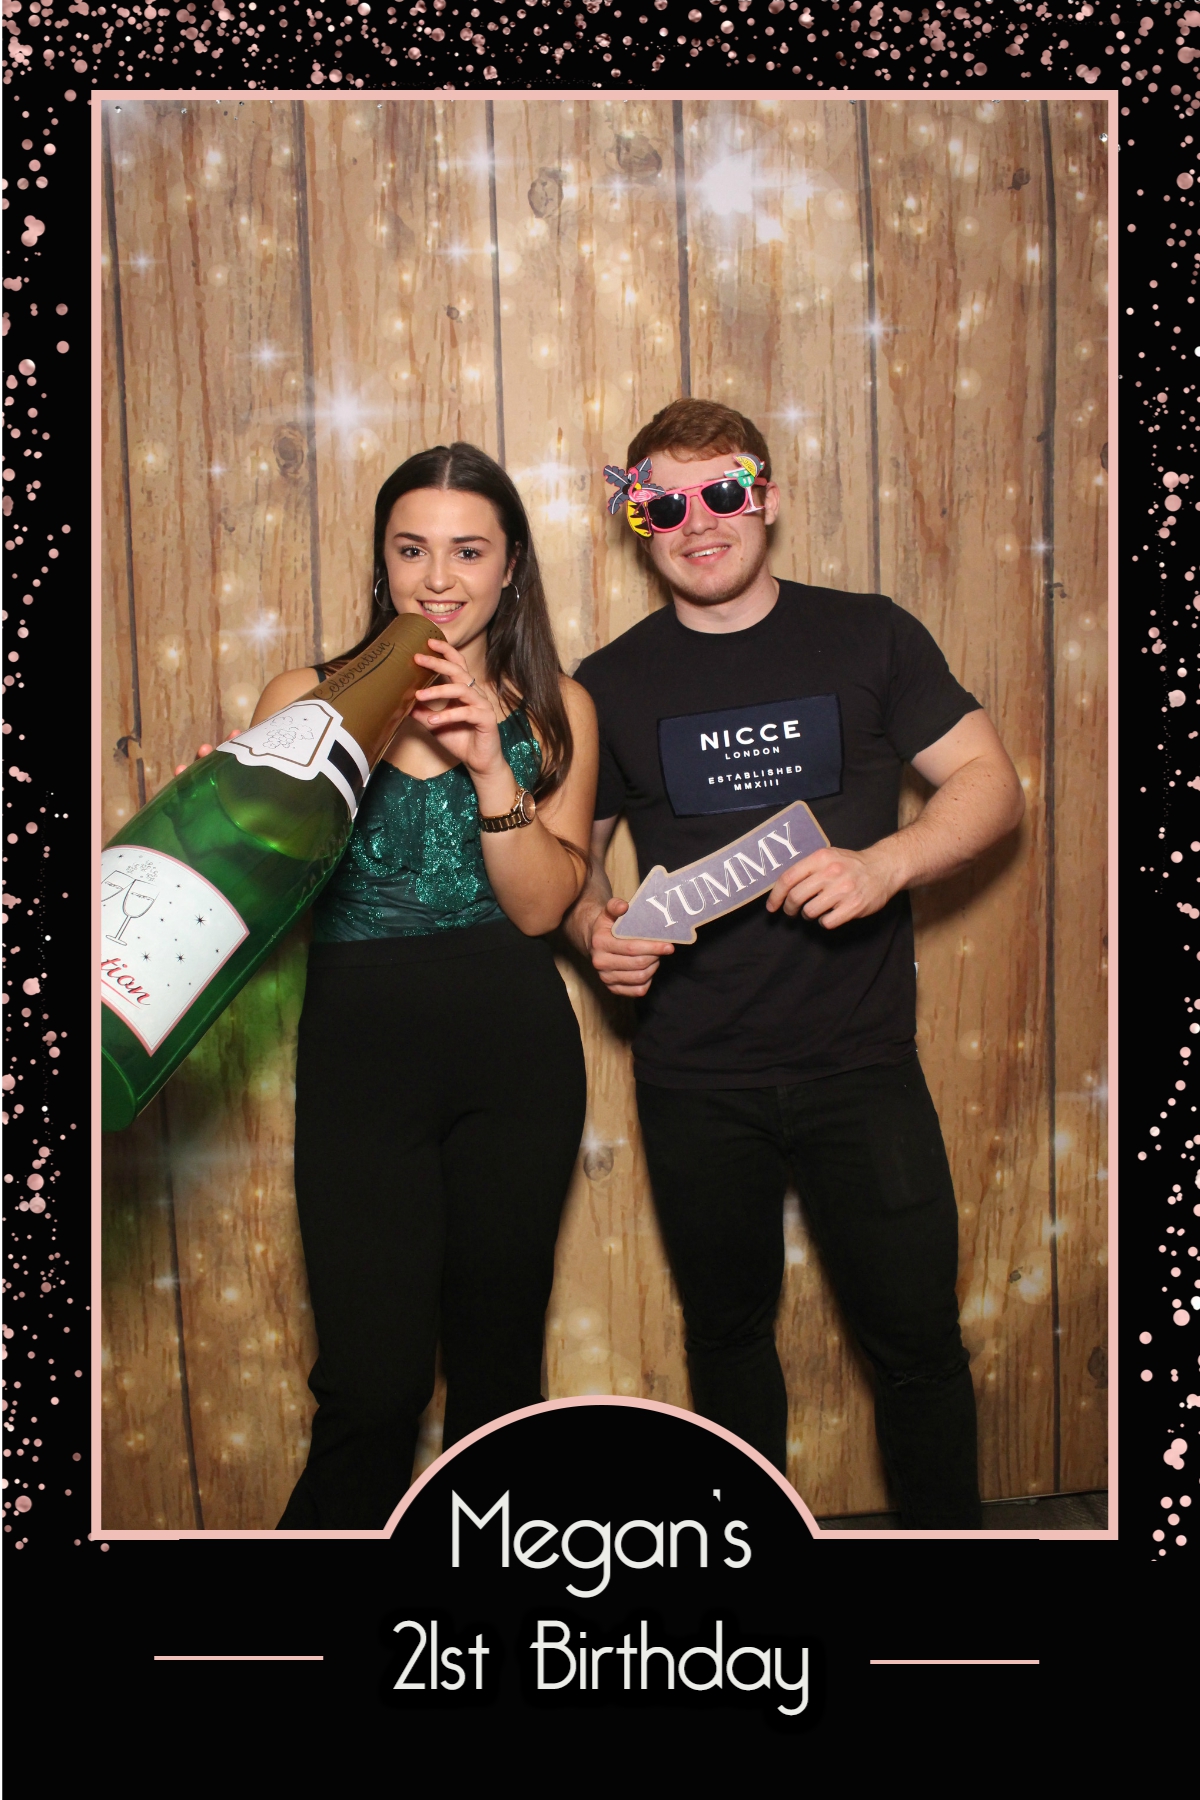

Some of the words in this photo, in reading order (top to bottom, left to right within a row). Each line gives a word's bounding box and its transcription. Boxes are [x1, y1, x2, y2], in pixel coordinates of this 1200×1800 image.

[313, 641, 391, 701] Celebration
[700, 720, 801, 751] NICCE
[725, 746, 780, 760] LONDON
[708, 765, 803, 785] ESTABLISHED
[733, 779, 780, 791] MMXIII
[646, 821, 803, 928] YUMMY
